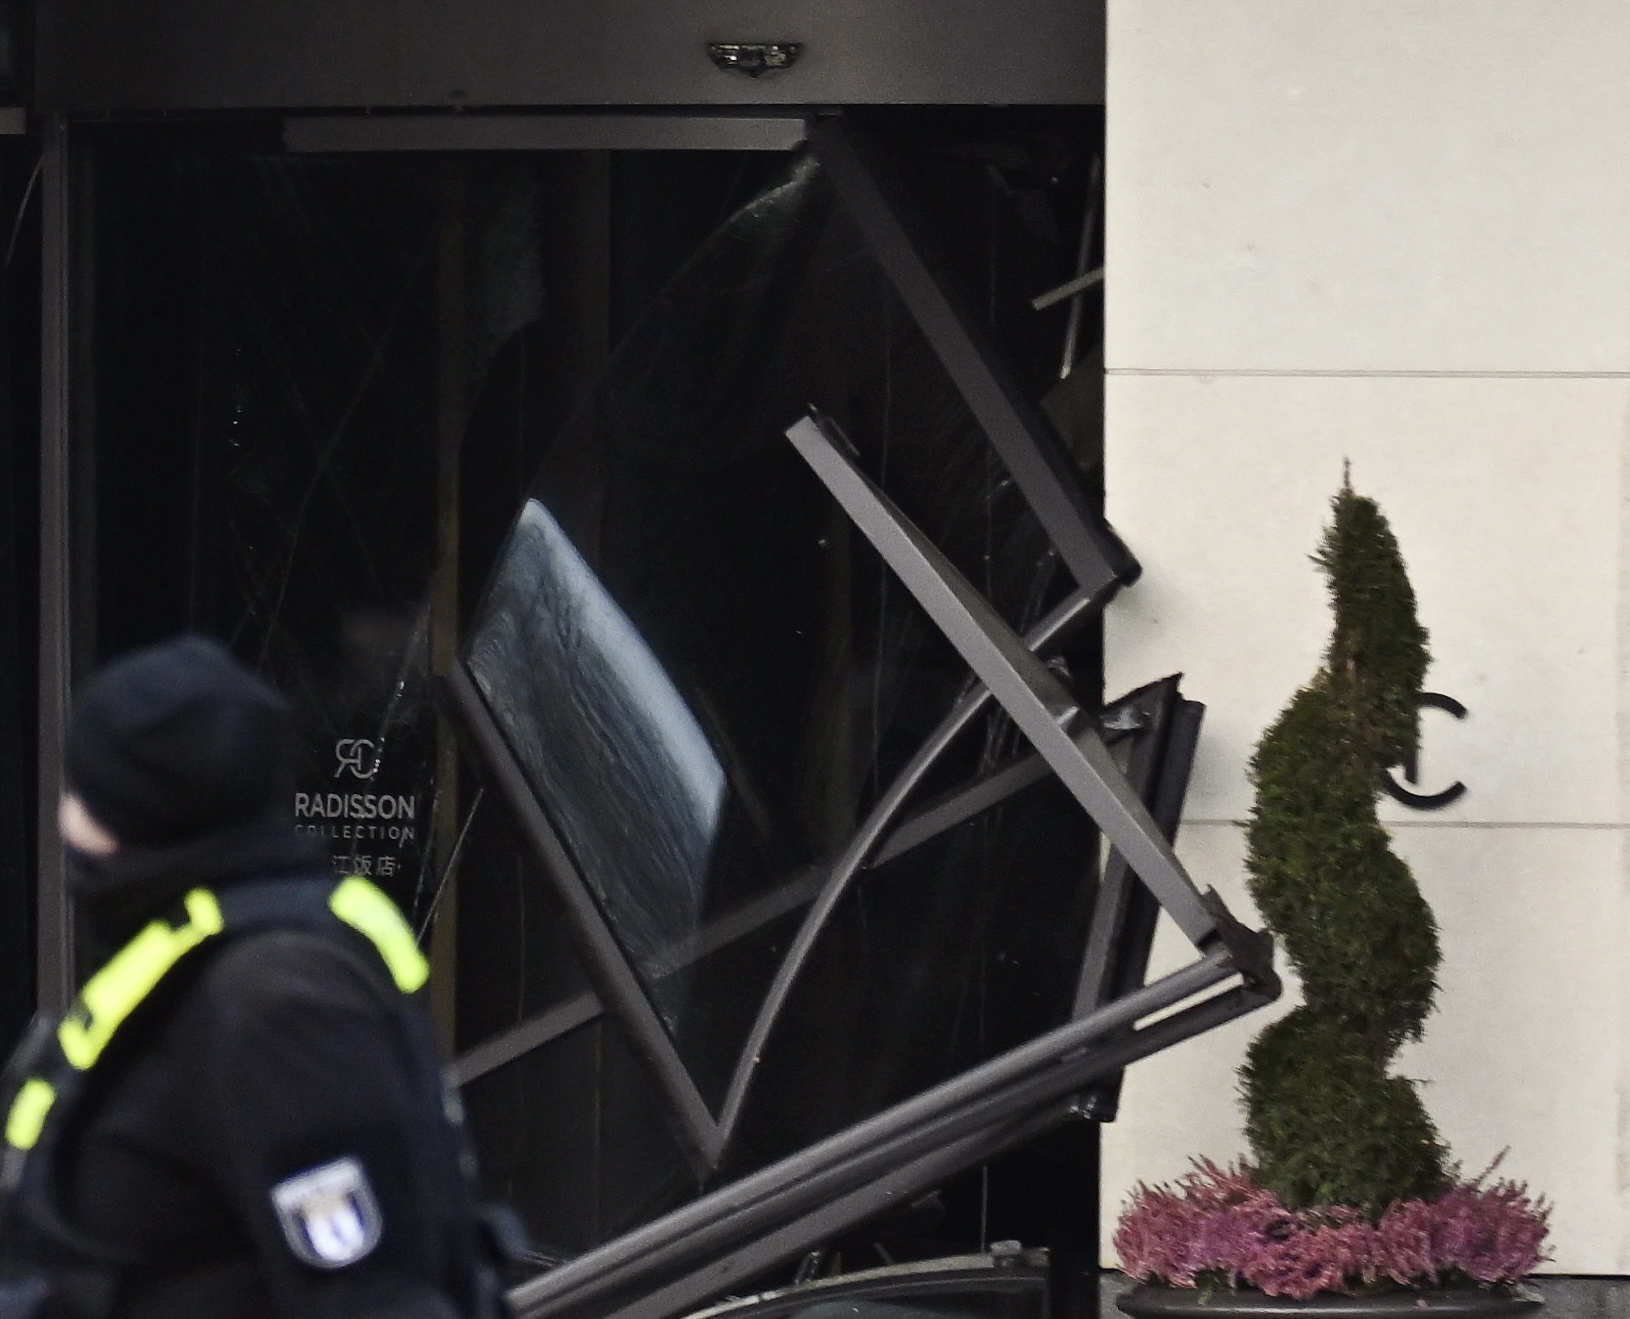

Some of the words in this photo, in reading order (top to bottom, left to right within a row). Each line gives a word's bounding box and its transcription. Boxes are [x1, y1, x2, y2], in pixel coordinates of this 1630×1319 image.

[294, 792, 416, 820] RADISSON
[294, 824, 415, 841] COLLECTION
[331, 854, 396, 878] 江饭店
